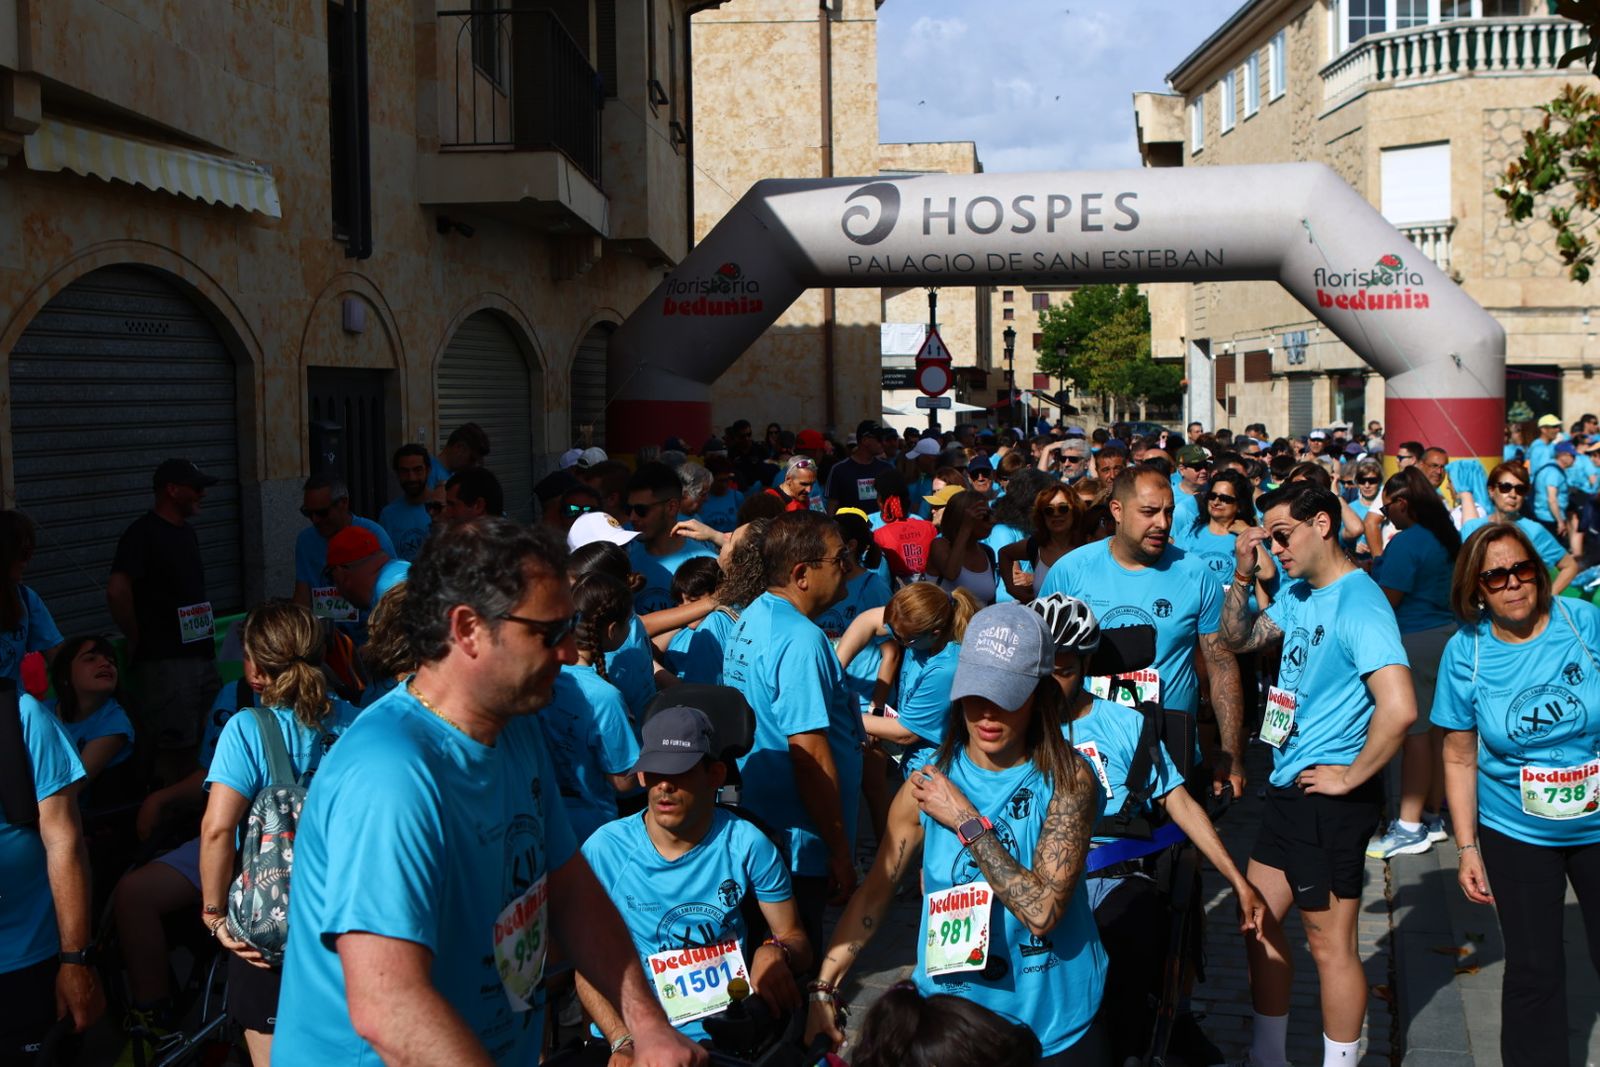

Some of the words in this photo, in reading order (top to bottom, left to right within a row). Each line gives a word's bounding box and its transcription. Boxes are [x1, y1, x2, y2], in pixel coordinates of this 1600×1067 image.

[923, 192, 1140, 236] HOSPES
[848, 252, 976, 275] PALACIO
[986, 252, 1024, 272] DE
[1033, 251, 1090, 271] SAN
[1102, 248, 1225, 271] ESTEBAN
[1313, 266, 1424, 288] floristería
[1316, 288, 1429, 311] bedunia
[975, 638, 1016, 658] MINDS
[978, 626, 1021, 645] CREATIVE
[1269, 708, 1290, 732] 1292
[1521, 701, 1564, 732] XII
[1522, 765, 1599, 783] bedunia
[1544, 783, 1587, 804] 738
[929, 887, 989, 916] bedunia
[940, 918, 972, 946] 981
[652, 938, 738, 976] bedunia
[674, 960, 736, 999] 1501
